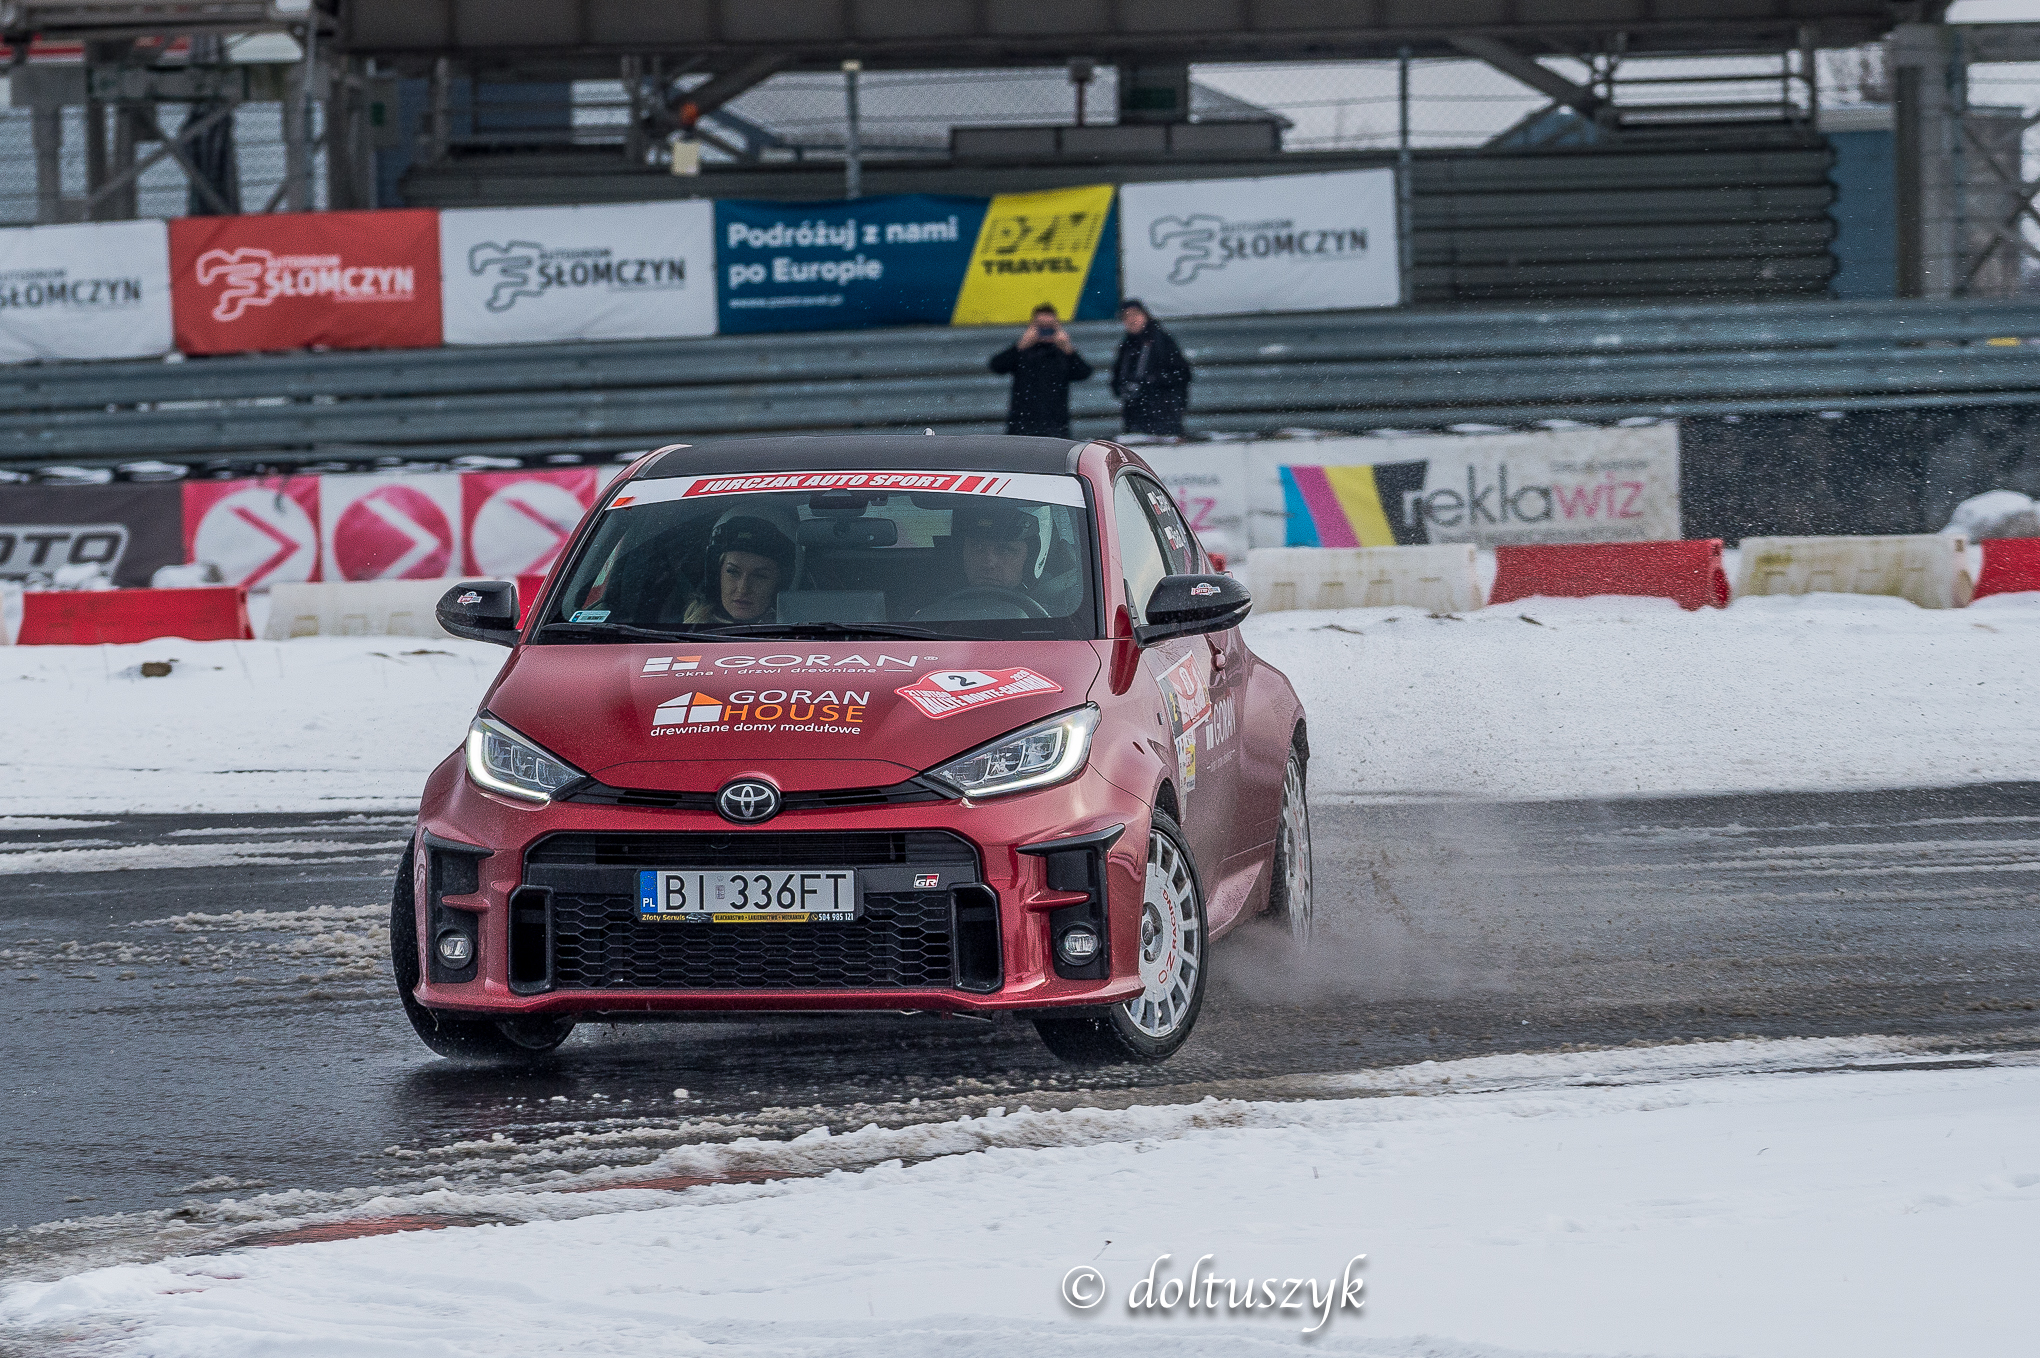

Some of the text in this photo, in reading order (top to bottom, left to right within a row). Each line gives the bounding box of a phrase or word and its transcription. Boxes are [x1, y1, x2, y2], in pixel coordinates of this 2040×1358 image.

[727, 214, 959, 251] Podróżuj z nami
[1220, 226, 1368, 261] SŁOMCZYN
[537, 257, 687, 288] SŁOMCZYN
[727, 253, 884, 290] po Europie
[981, 255, 1080, 276] TRAVEL
[265, 265, 415, 298] SŁOMCZYN
[698, 474, 950, 494] JURCZAK AUTO SPORT
[1403, 462, 1645, 528] reklawiz
[947, 674, 978, 688] 2
[729, 689, 871, 706] GORAN
[723, 704, 866, 723] HOUSE
[650, 722, 861, 737] drewniane domy modułowe
[665, 873, 847, 911] BI 336FT
[915, 878, 938, 888] GR
[642, 898, 656, 908] PL
[642, 914, 661, 922] Złoty
[1162, 888, 1178, 950] RACING
